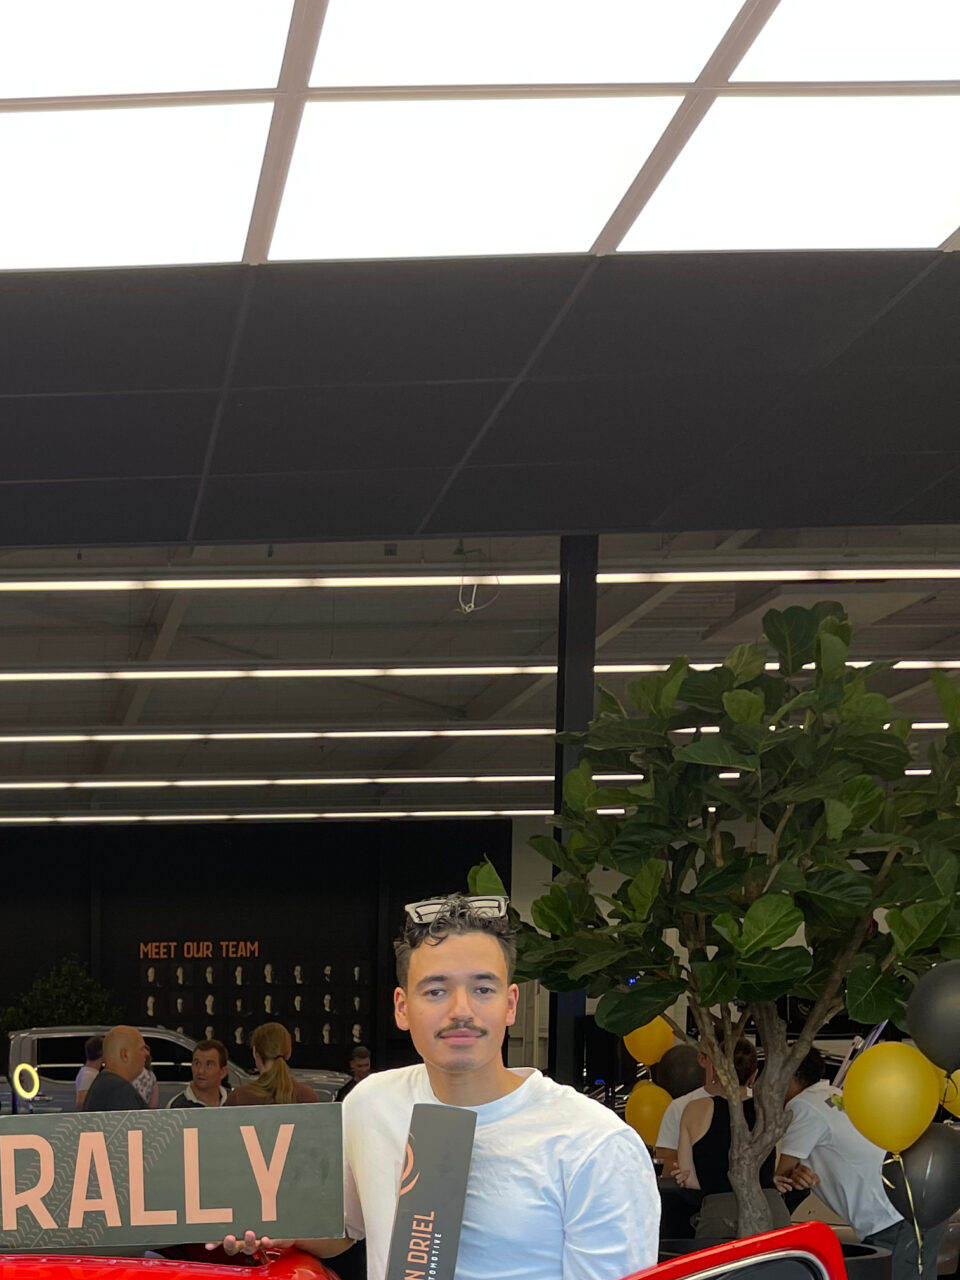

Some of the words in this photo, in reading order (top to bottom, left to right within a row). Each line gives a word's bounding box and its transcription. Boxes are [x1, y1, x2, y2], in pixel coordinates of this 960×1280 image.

[139, 942, 177, 959] MEET
[183, 941, 213, 958] OUR
[220, 941, 259, 958] TEAM
[407, 1210, 435, 1264] DRIEL
